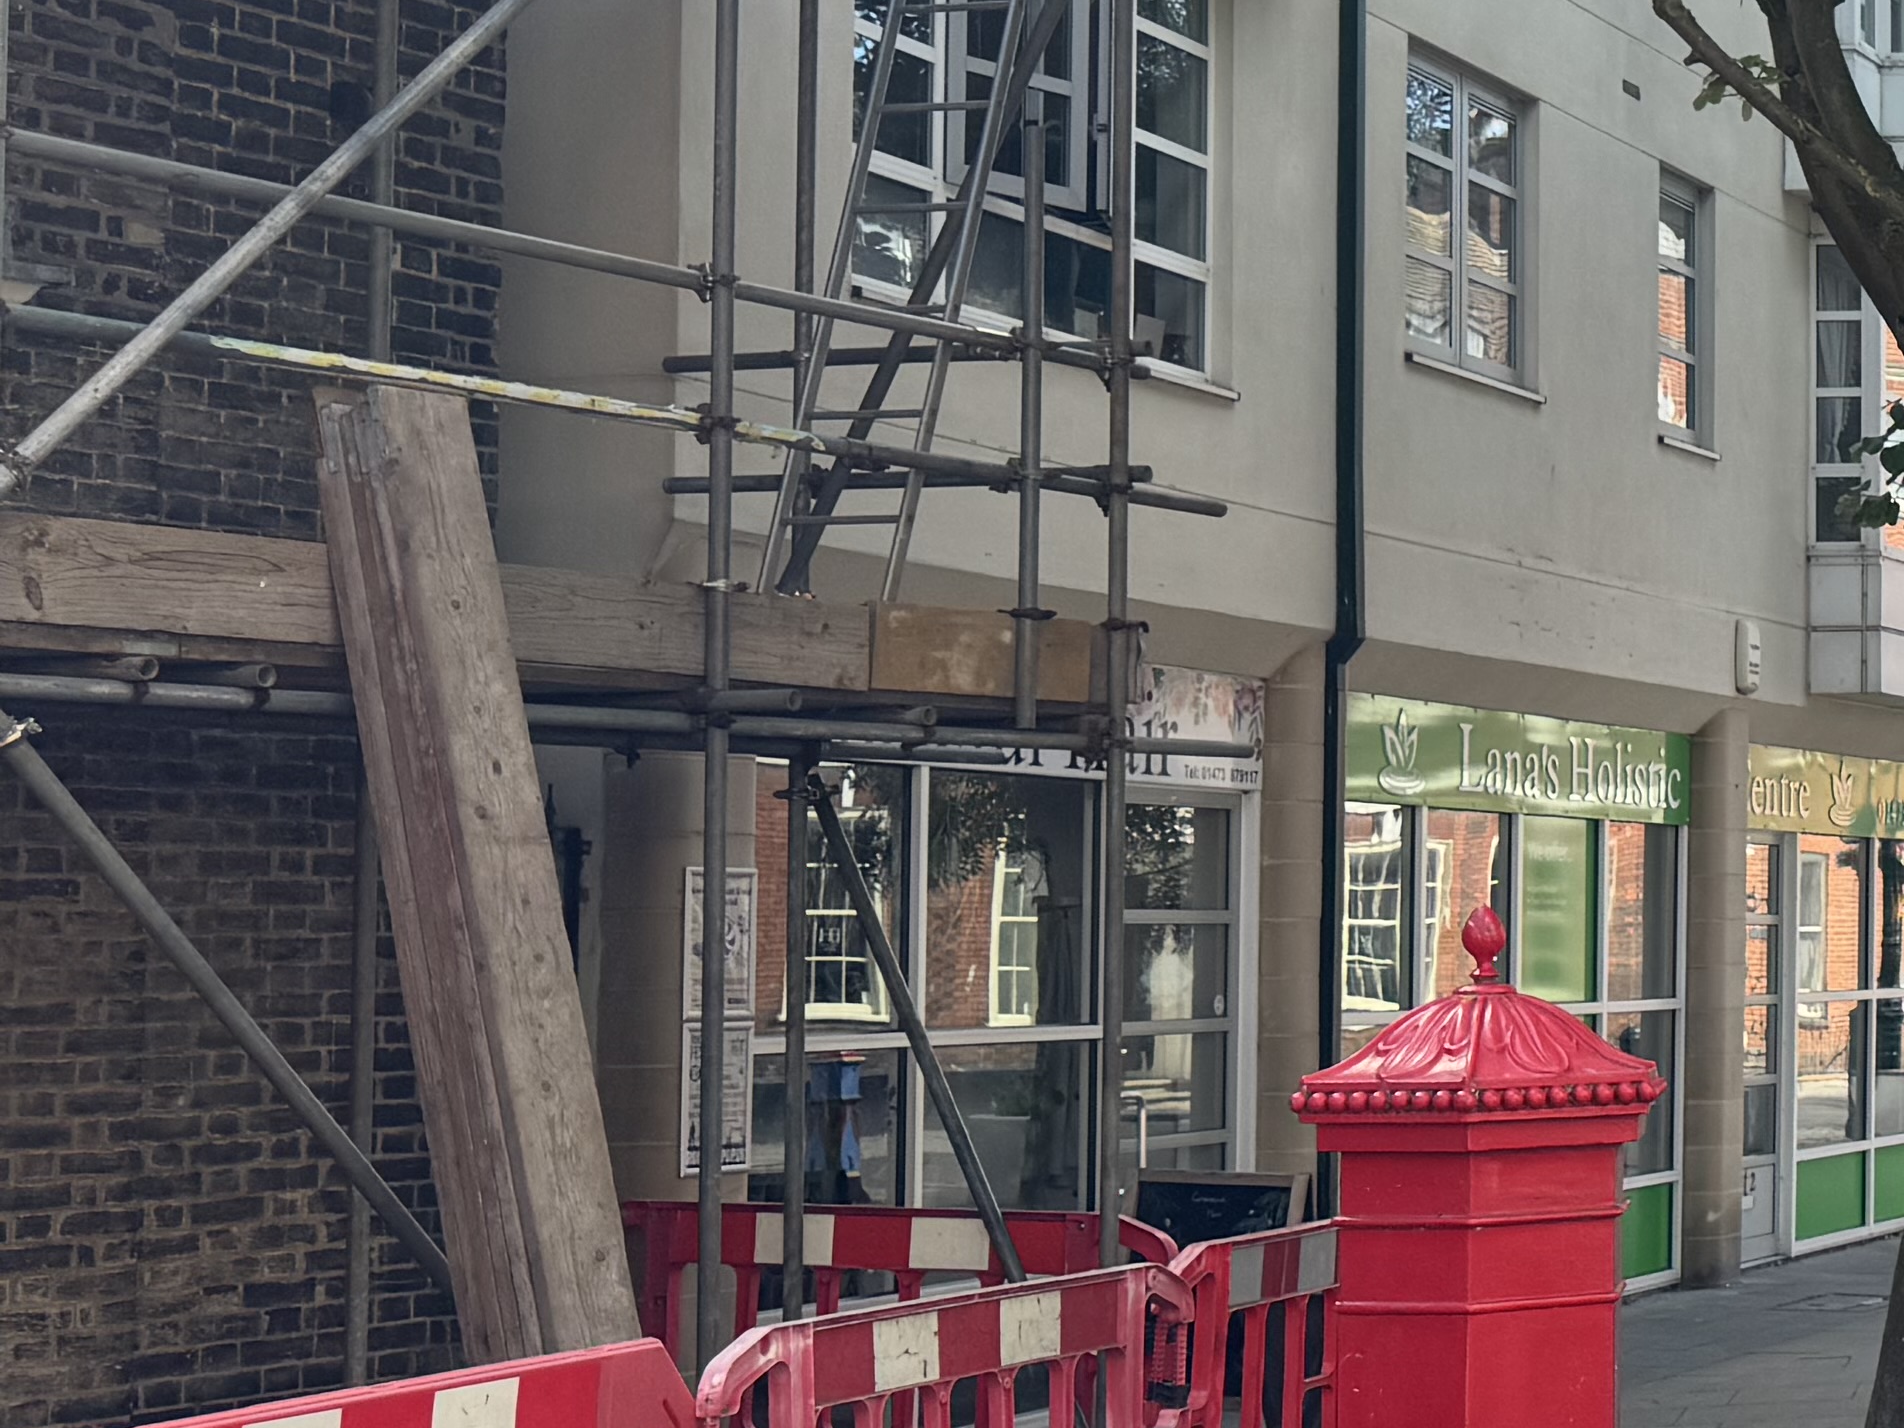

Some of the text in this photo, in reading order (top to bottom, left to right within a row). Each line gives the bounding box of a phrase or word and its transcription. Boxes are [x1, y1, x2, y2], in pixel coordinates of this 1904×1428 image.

[1458, 723, 1681, 809] Lana's Holistic
[1748, 773, 1812, 819] entre
